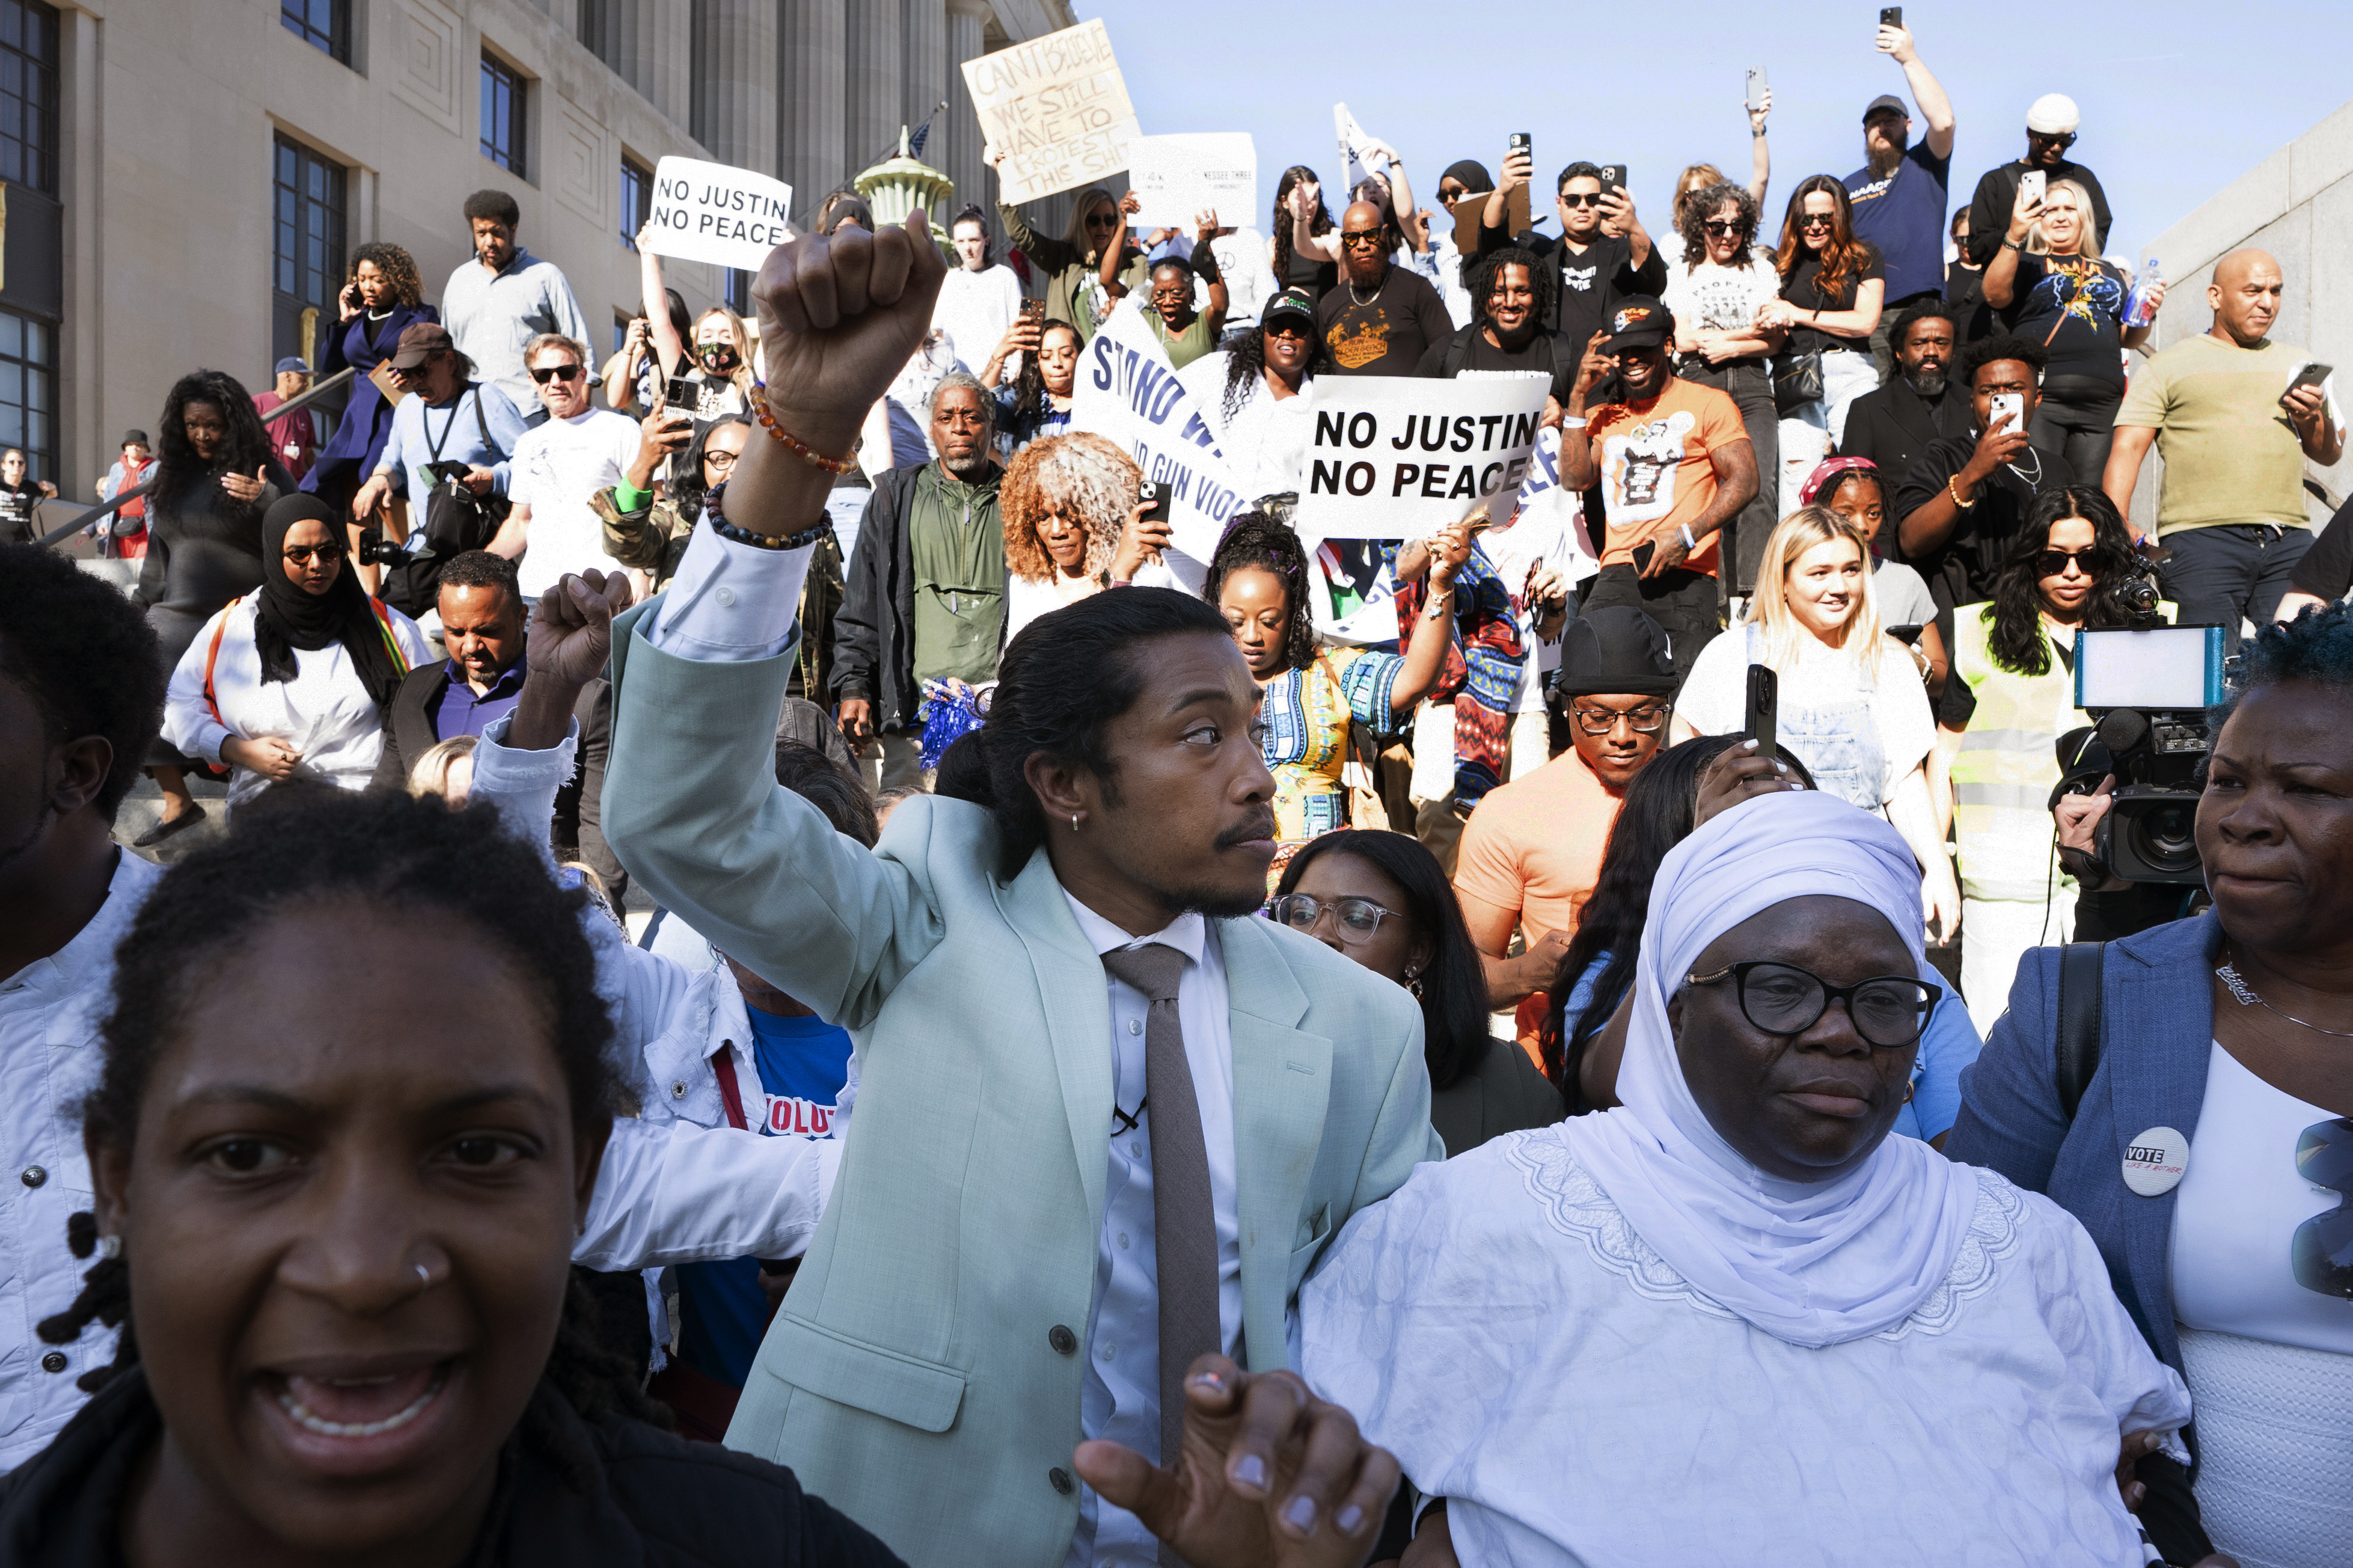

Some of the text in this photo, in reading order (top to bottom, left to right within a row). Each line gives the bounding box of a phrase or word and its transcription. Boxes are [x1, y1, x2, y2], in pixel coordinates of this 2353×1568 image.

[990, 78, 1108, 130] WE STILL
[996, 106, 1112, 156] HAVE TO
[1014, 124, 1119, 175] PROTEST
[1016, 163, 1076, 192] THIS
[1232, 171, 1253, 180] THREE
[658, 178, 786, 221] NO JUSTIN
[655, 206, 783, 246] NO PEACE
[1315, 410, 1540, 452] NO JUSTIN
[1151, 453, 1192, 501] GUN
[1310, 459, 1375, 496] NO
[1392, 457, 1528, 499] PEACE
[766, 1097, 835, 1133] OLU
[2129, 1147, 2164, 1162] VOTE
[2153, 1165, 2182, 1175] MOTHER
